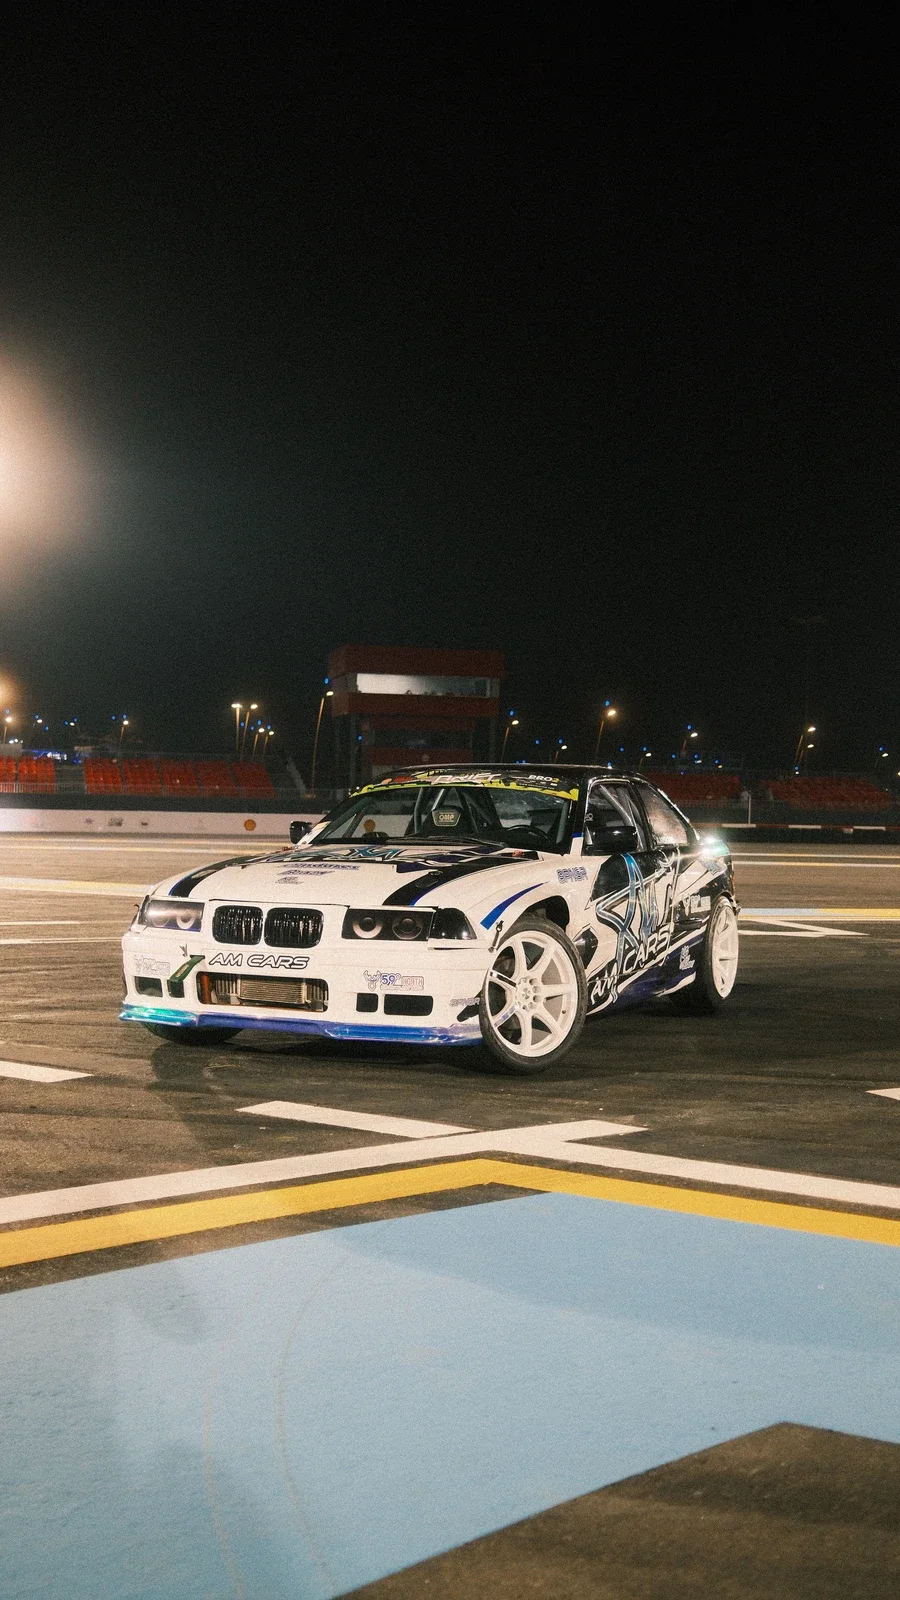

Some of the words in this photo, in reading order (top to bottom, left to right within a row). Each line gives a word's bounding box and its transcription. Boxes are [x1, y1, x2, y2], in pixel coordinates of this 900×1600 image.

[439, 814, 455, 822] OMP
[209, 953, 243, 966] AM
[247, 954, 310, 970] CARS
[590, 963, 617, 1005] AM
[623, 922, 674, 973] CARS
